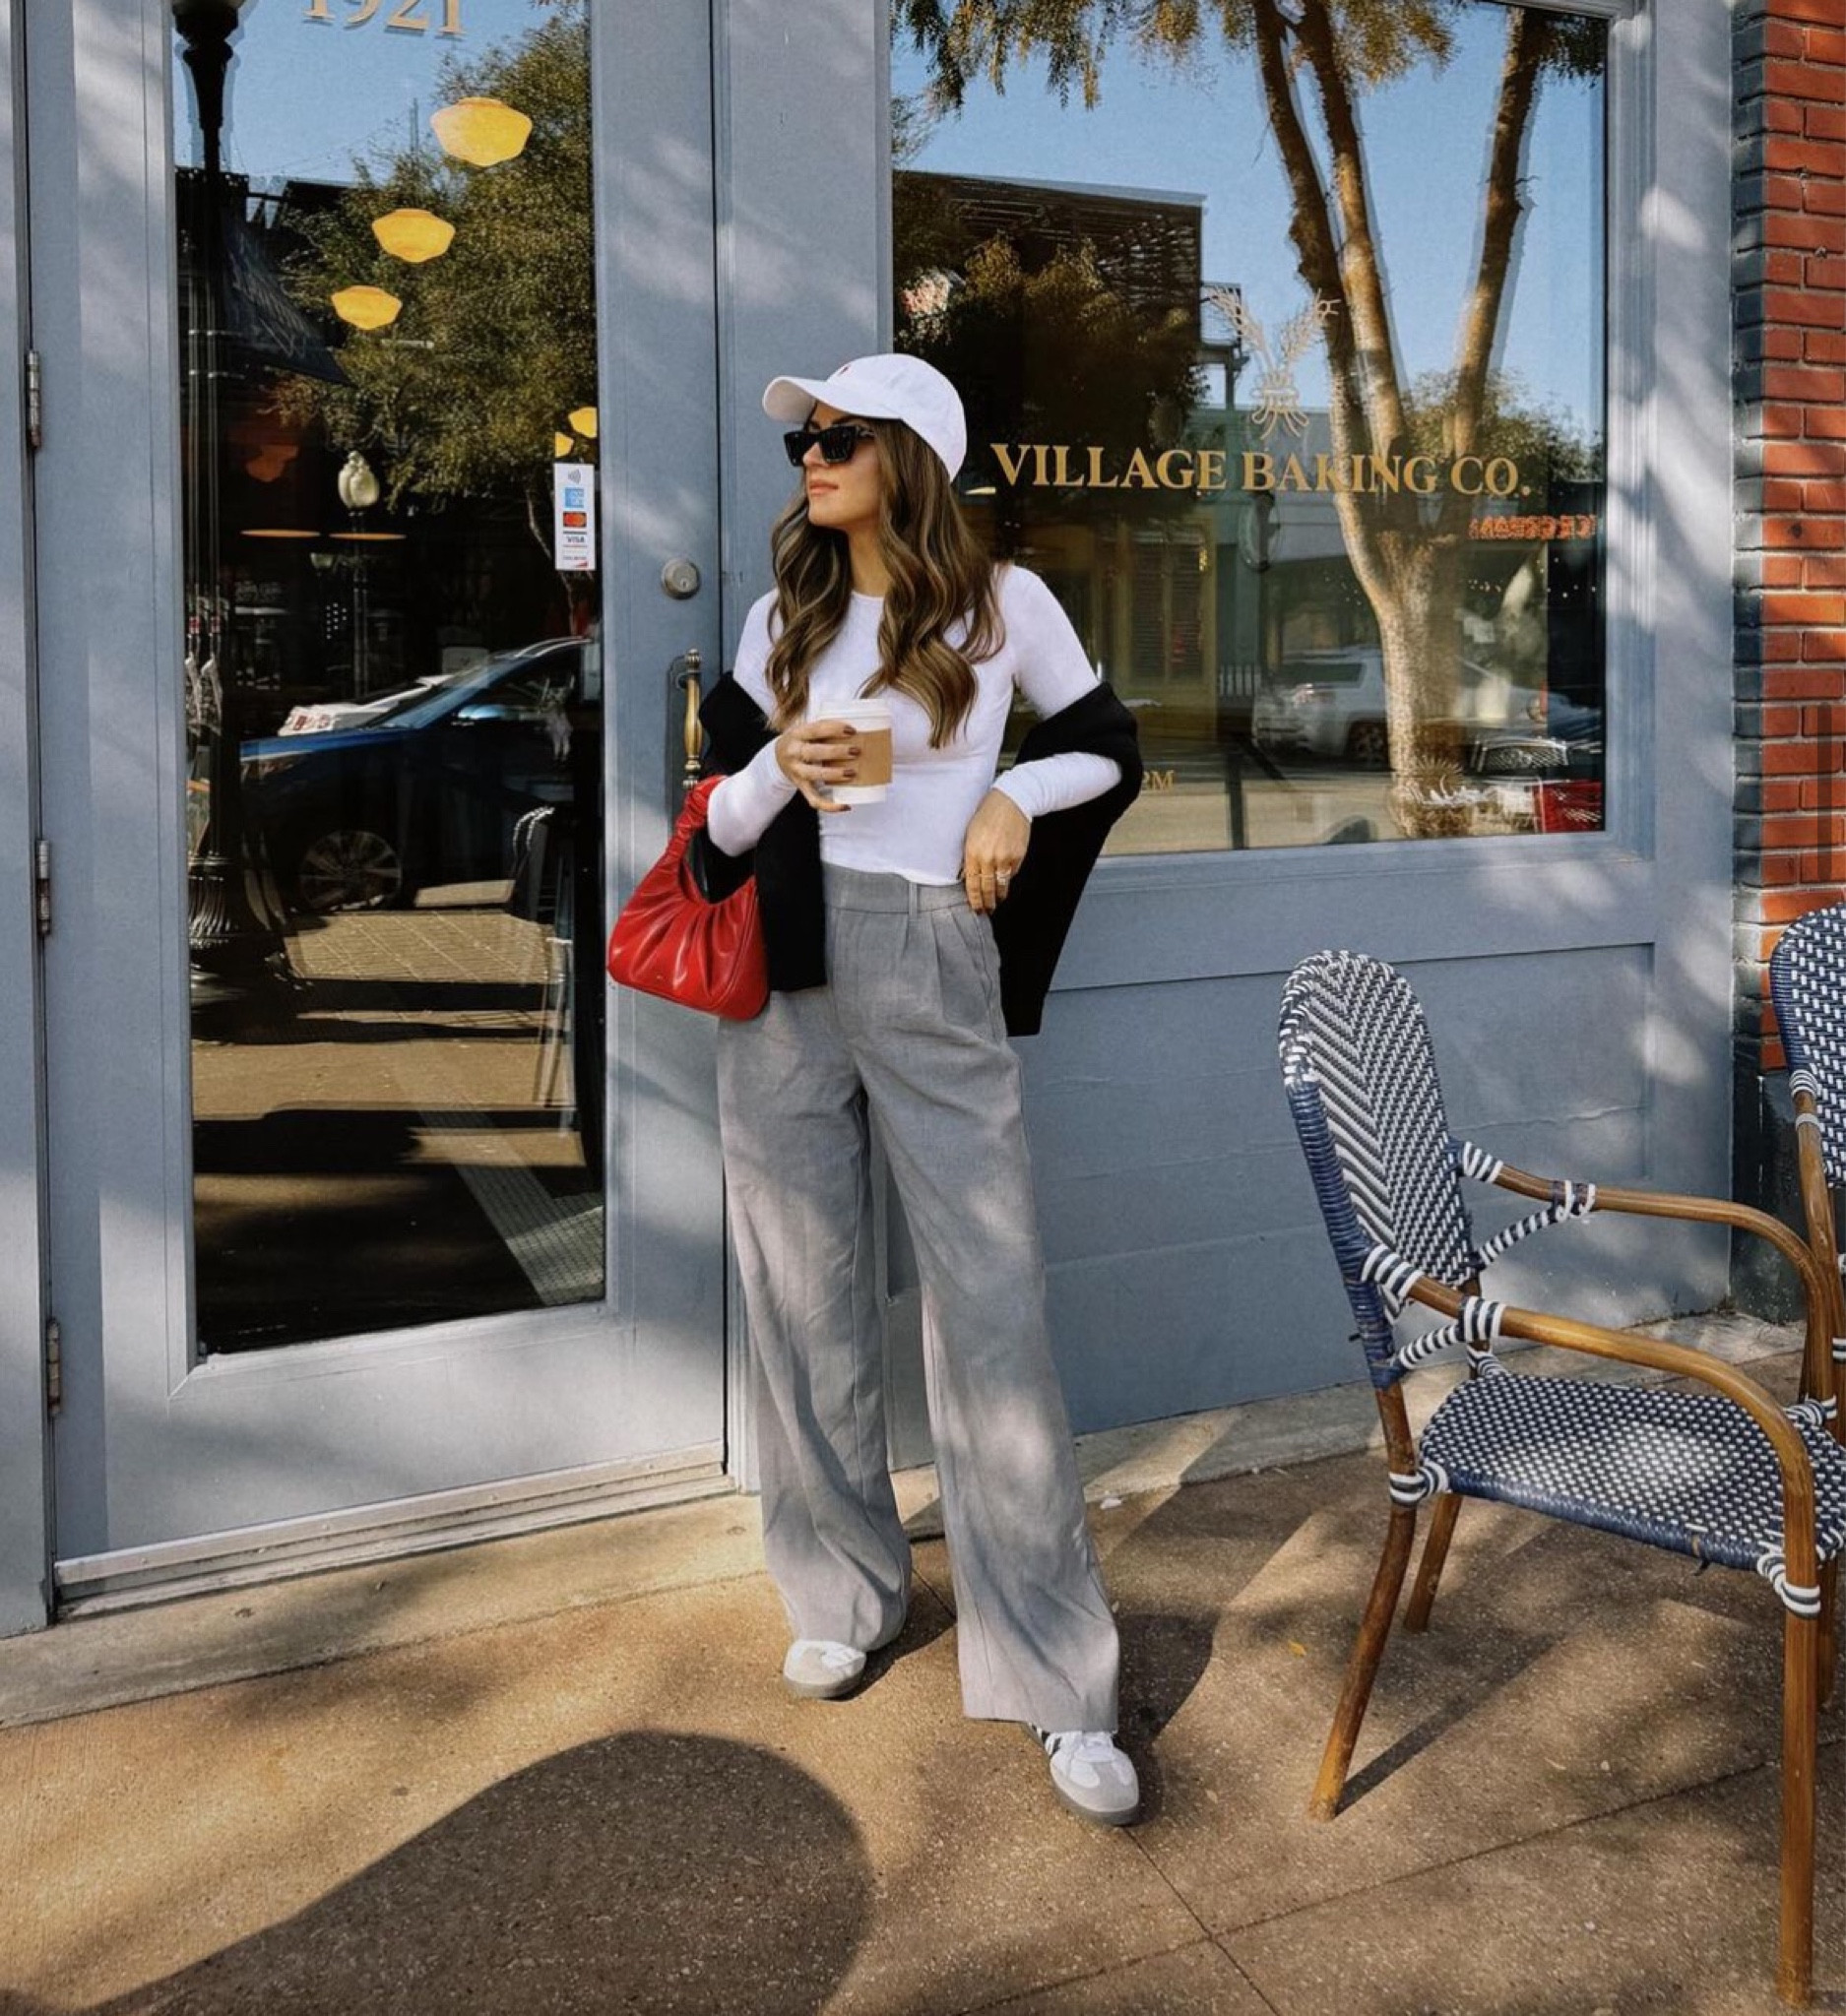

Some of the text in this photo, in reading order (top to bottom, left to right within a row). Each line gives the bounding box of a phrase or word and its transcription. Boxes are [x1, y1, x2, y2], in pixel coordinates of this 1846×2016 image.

[990, 443, 1531, 496] VILLAGE BAKING CO.
